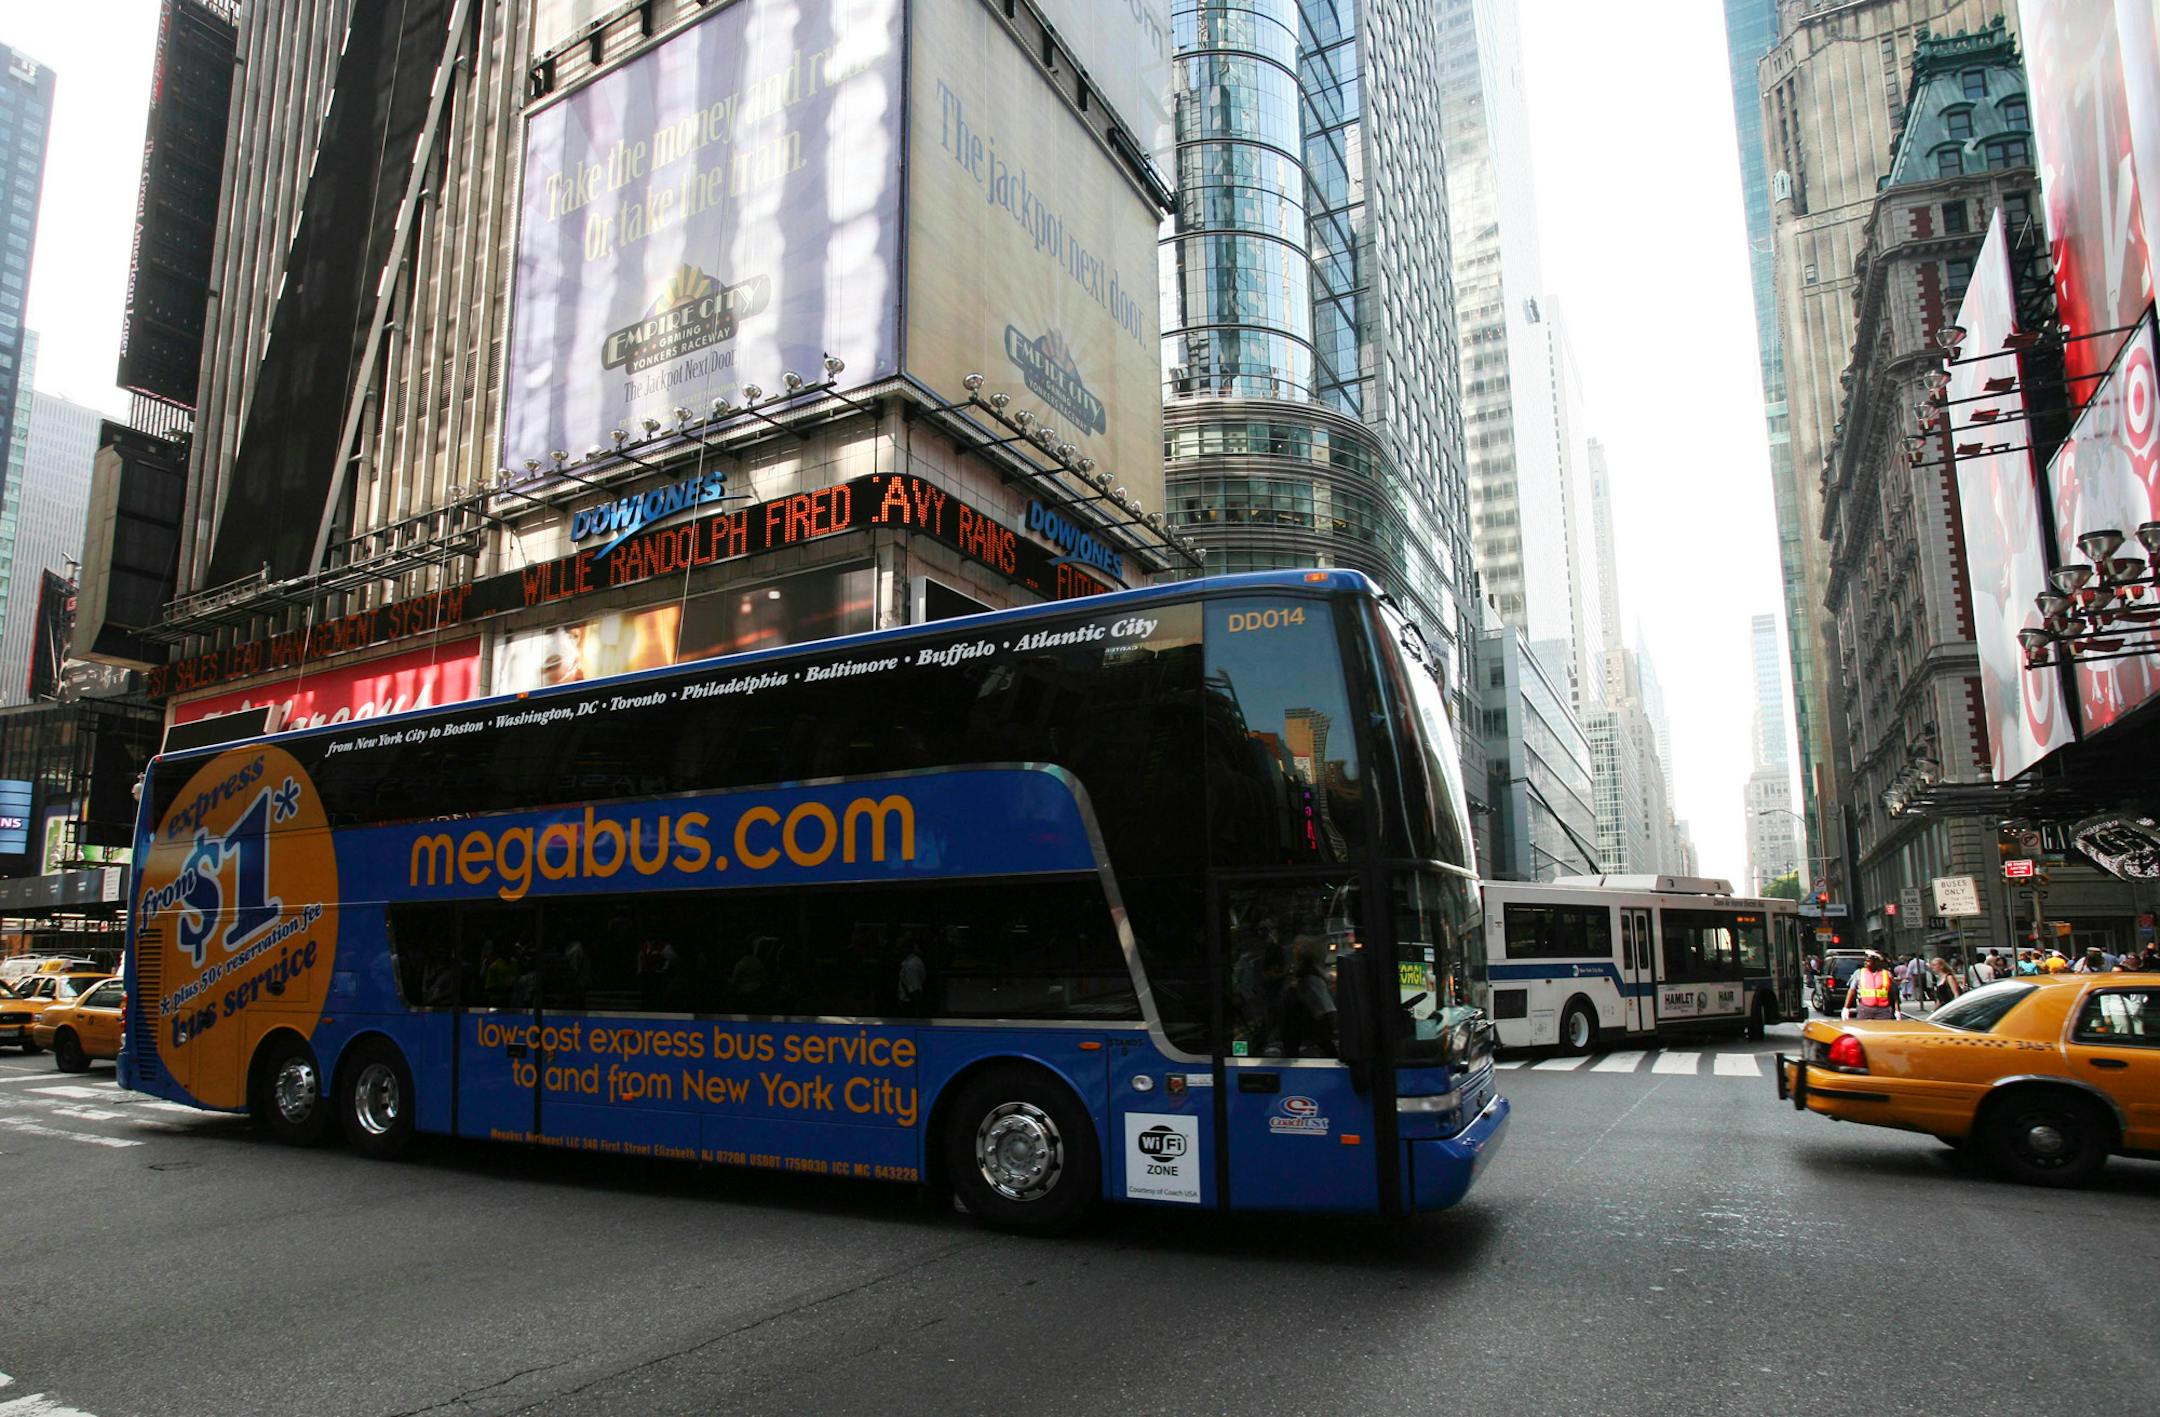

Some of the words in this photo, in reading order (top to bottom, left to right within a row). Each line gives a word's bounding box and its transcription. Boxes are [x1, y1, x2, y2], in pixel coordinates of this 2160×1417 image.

[144, 139, 154, 168] The
[544, 161, 600, 223] Take
[607, 138, 645, 193] the
[651, 92, 739, 173] money
[744, 50, 802, 124] and
[136, 172, 150, 218] Great
[584, 211, 615, 262] Or,
[618, 184, 673, 249] take
[680, 160, 723, 218] the
[937, 78, 984, 184] The
[985, 137, 1065, 267] jackpot
[1069, 234, 1106, 309] next
[126, 222, 144, 304] American
[120, 309, 134, 358] Lager
[607, 304, 695, 365] EMPIRE
[701, 279, 762, 318] CITY
[633, 343, 678, 371] YONKERS
[681, 327, 731, 352] RACEWAY
[659, 325, 701, 347] GAMING
[623, 381, 643, 403] The
[644, 365, 683, 395] Jackpot
[684, 356, 710, 381] Next
[522, 551, 594, 607] WILLIE
[609, 509, 748, 585] RANDOLPH
[765, 484, 852, 548] FIRED
[871, 475, 947, 535] AVY
[958, 503, 1017, 574] RAINS
[176, 653, 220, 691] SALES
[225, 640, 260, 679] LEAD
[270, 612, 379, 668] MANAGEMENT
[325, 735, 353, 758] from
[355, 734, 380, 751] New
[378, 729, 403, 748] York
[405, 724, 429, 744] City
[430, 725, 442, 739] to
[443, 720, 484, 736] Boston
[495, 704, 574, 729] Washington,
[576, 700, 599, 717] DC
[610, 691, 666, 711] Toronto
[680, 671, 789, 701] Philadelphia
[804, 655, 898, 683] Baltimore
[915, 640, 996, 667] Buffalo
[1012, 625, 1105, 653] Atlantic
[1110, 616, 1158, 640] City
[168, 755, 264, 839] express
[409, 795, 916, 901] megabus.com
[138, 868, 197, 938] from
[1941, 880, 1967, 888] BUSES
[226, 921, 299, 975] reservation
[300, 903, 323, 932] fee
[171, 1002, 217, 1048] bus
[223, 940, 317, 1018] service
[1664, 993, 1694, 1005] HAMLET
[1718, 991, 1734, 1002] HAIR
[477, 1017, 581, 1052] low-cost
[589, 1028, 704, 1062] express
[714, 1024, 775, 1062] bus
[784, 1029, 917, 1068] service
[512, 1057, 537, 1088] to
[545, 1064, 599, 1094] and
[608, 1063, 672, 1103] from
[682, 1069, 750, 1104] New
[760, 1072, 834, 1112] York
[844, 1076, 918, 1127] City
[1147, 1164, 1178, 1176] ZONE
